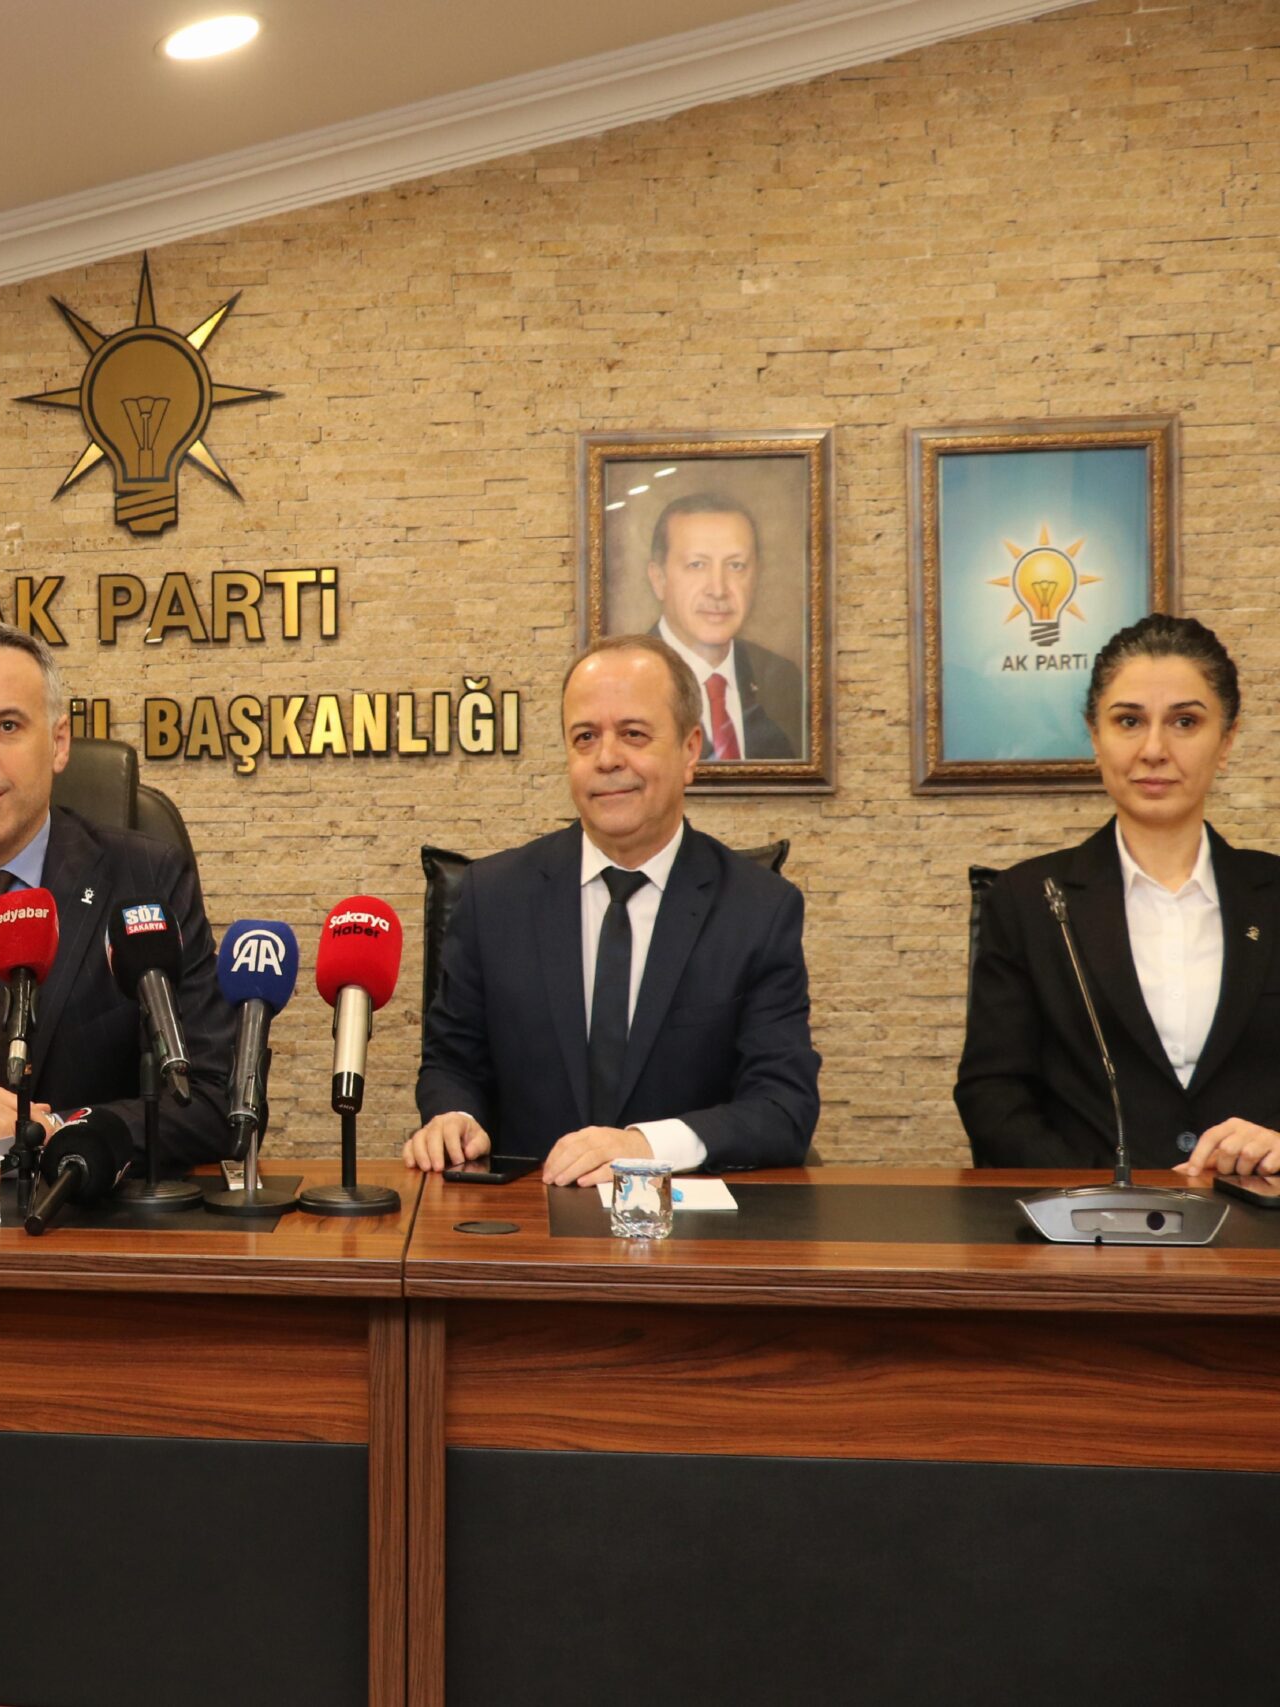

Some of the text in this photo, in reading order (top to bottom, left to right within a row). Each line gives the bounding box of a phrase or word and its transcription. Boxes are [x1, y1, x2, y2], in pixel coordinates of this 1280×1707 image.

[1002, 655, 1028, 671] AK
[144, 676, 520, 776] BAŞKANLIĞI
[125, 905, 163, 925] SÖZ
[128, 922, 164, 934] SAKARYA
[231, 938, 283, 976] AA
